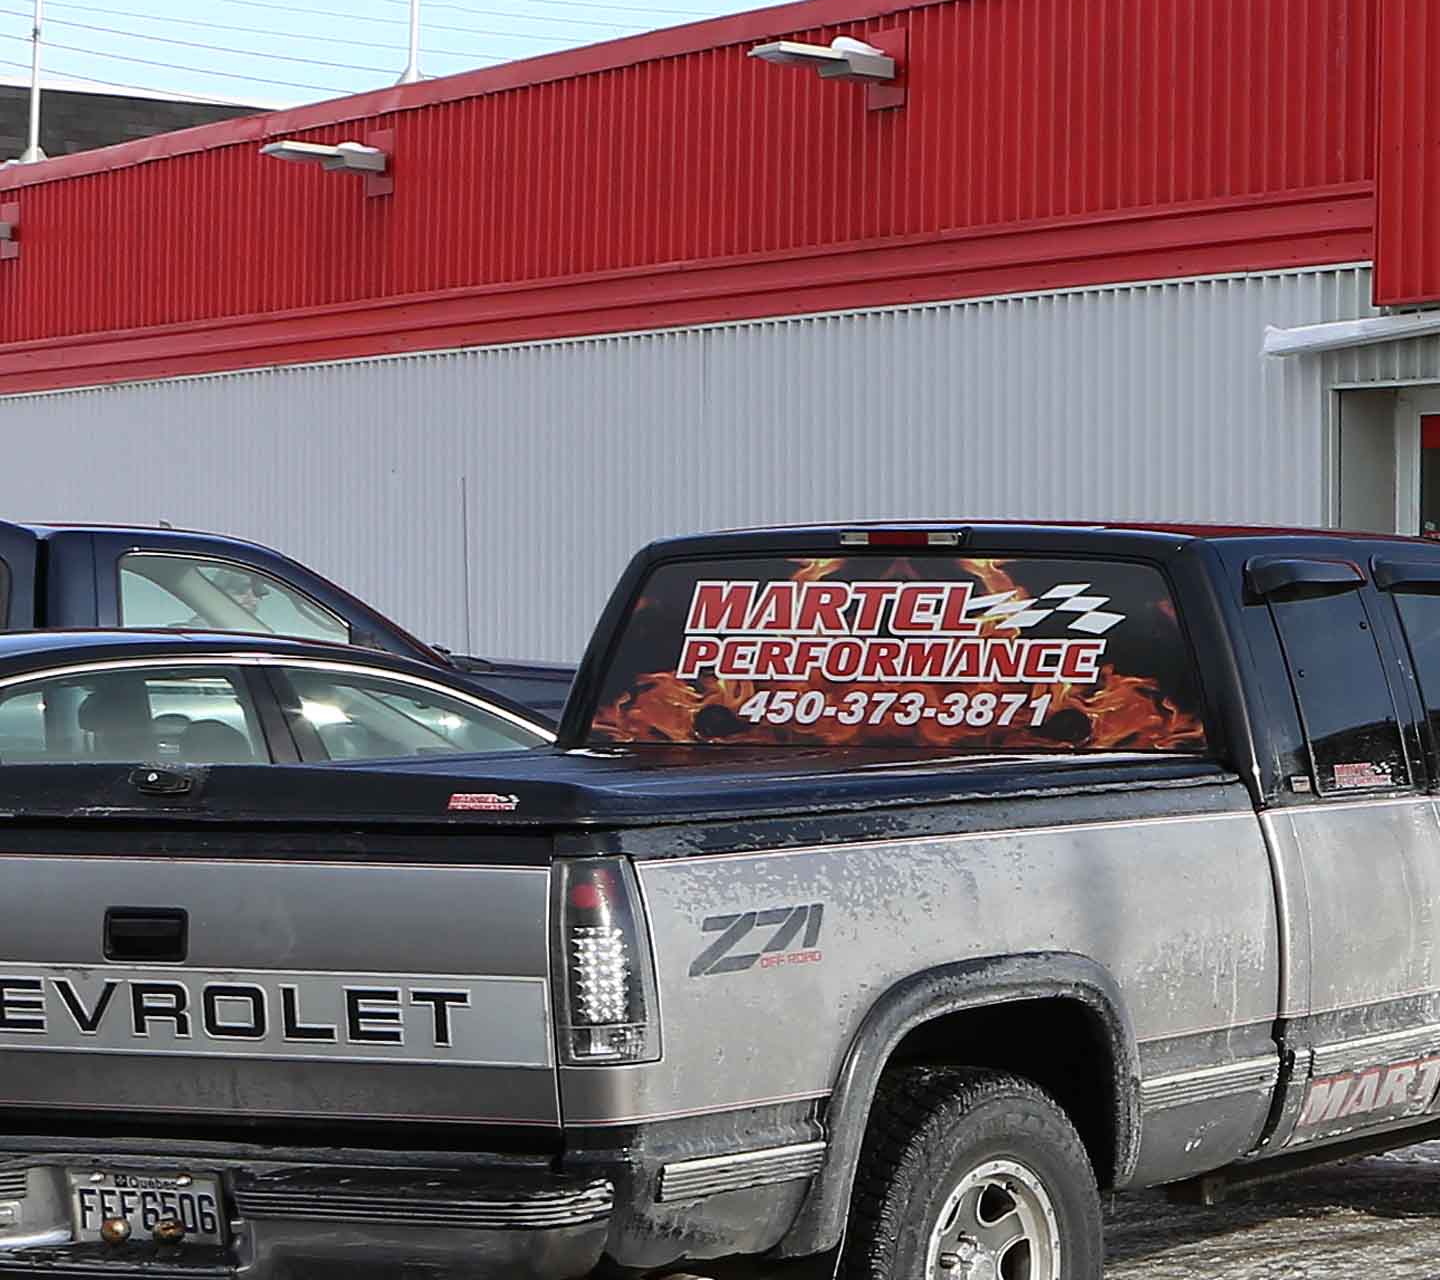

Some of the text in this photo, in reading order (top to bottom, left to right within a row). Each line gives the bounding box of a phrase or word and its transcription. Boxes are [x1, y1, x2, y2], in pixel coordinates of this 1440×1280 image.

[684, 581, 982, 635] MARTEL
[676, 638, 1107, 684] PERFORMANCE
[738, 691, 1052, 727] 450-373-3871
[689, 903, 824, 977] Z71
[760, 951, 822, 968] OFF ROAD
